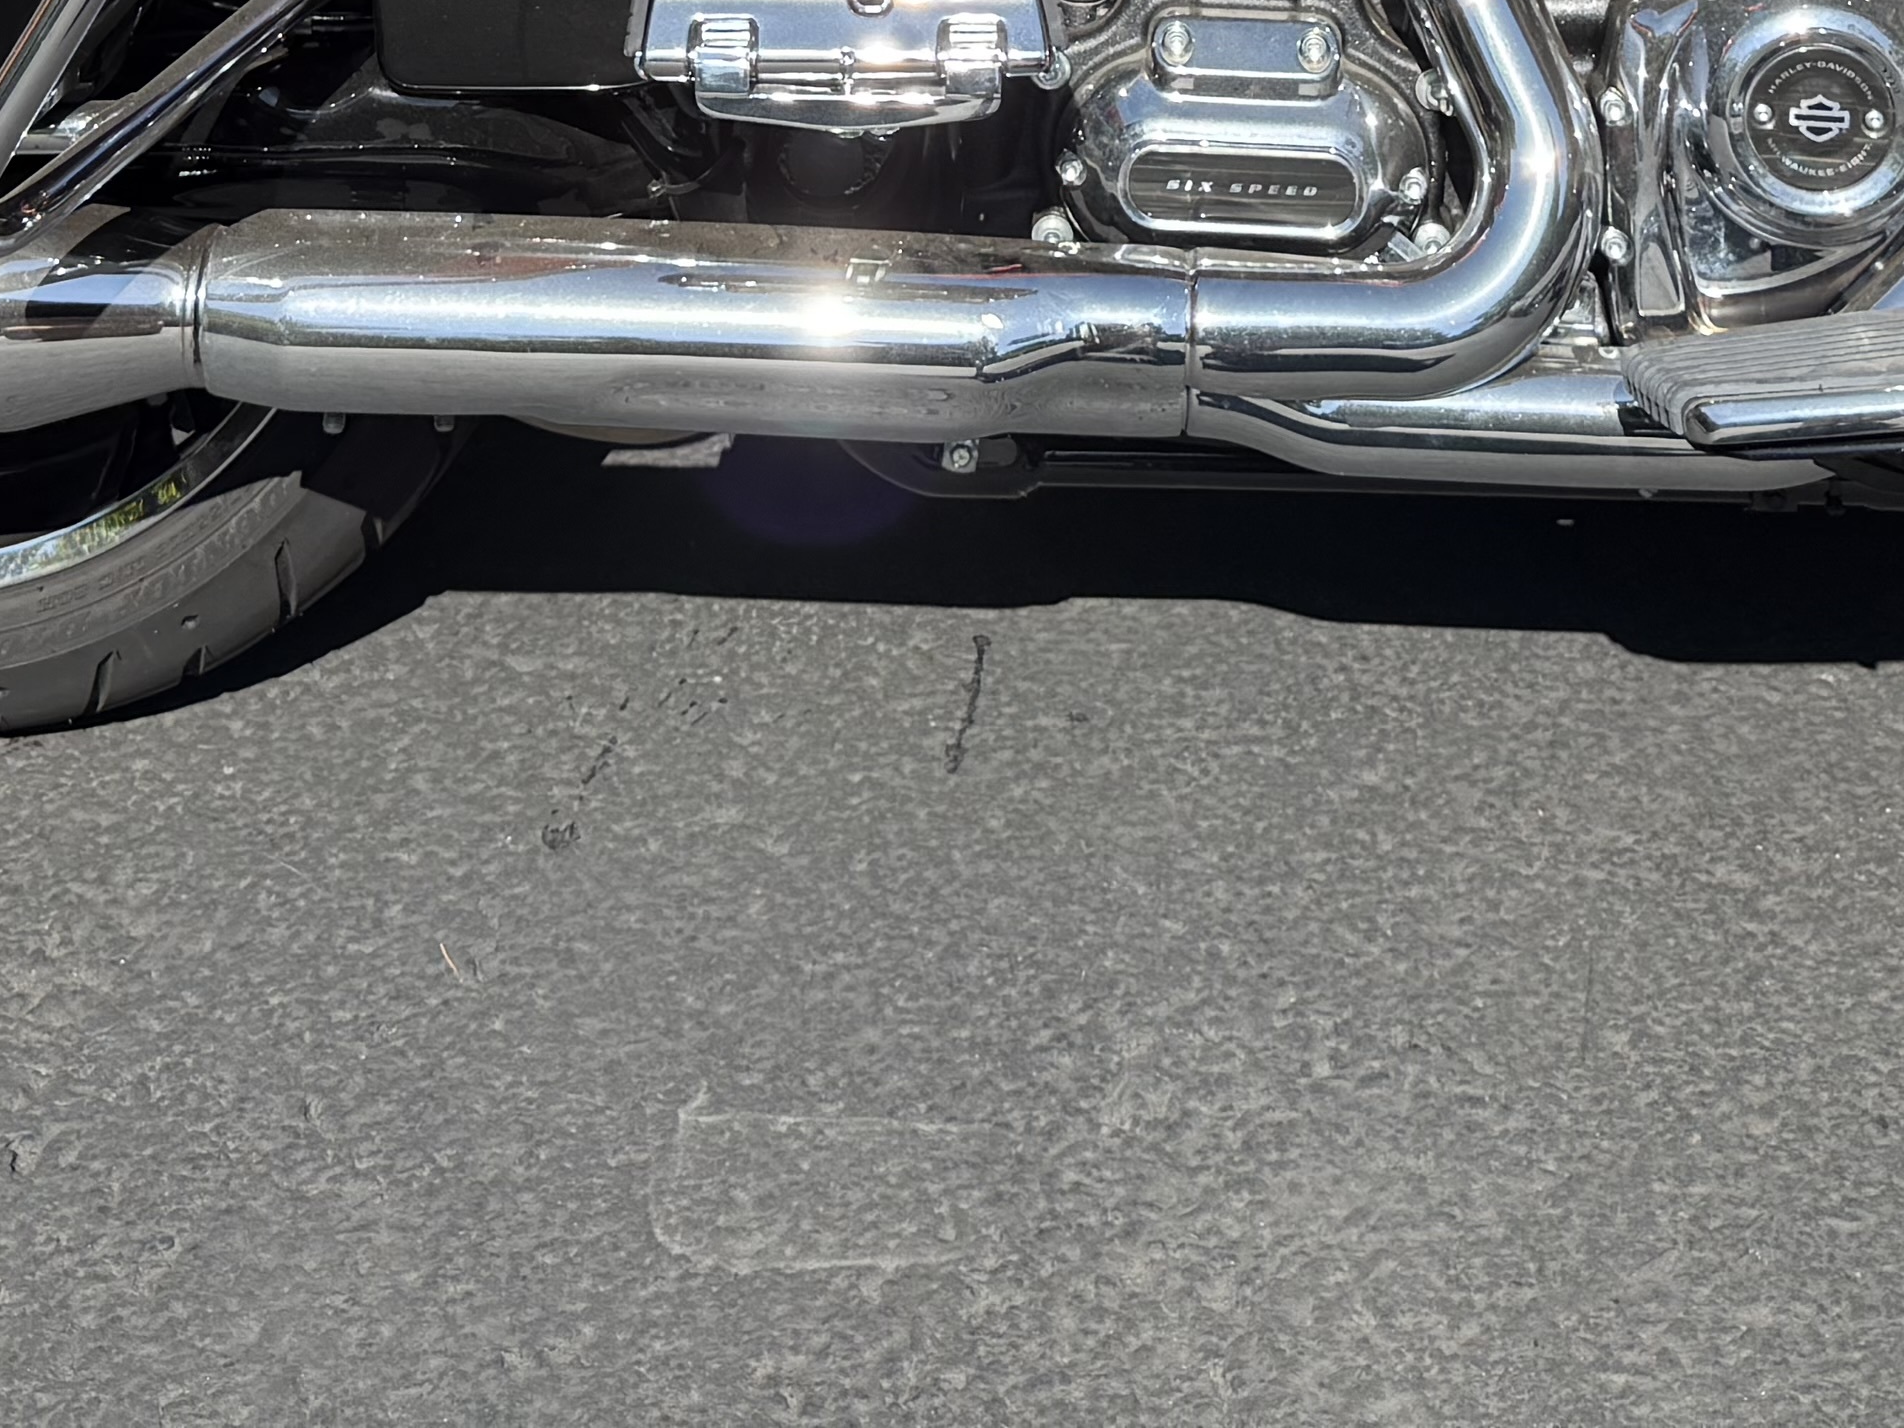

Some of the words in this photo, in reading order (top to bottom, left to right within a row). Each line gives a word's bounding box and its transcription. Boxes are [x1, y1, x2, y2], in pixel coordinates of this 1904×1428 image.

[1767, 60, 1873, 101] HARLEY-DAVIDSON
[1166, 180, 1213, 193] SIX
[1229, 183, 1318, 197] SPEED
